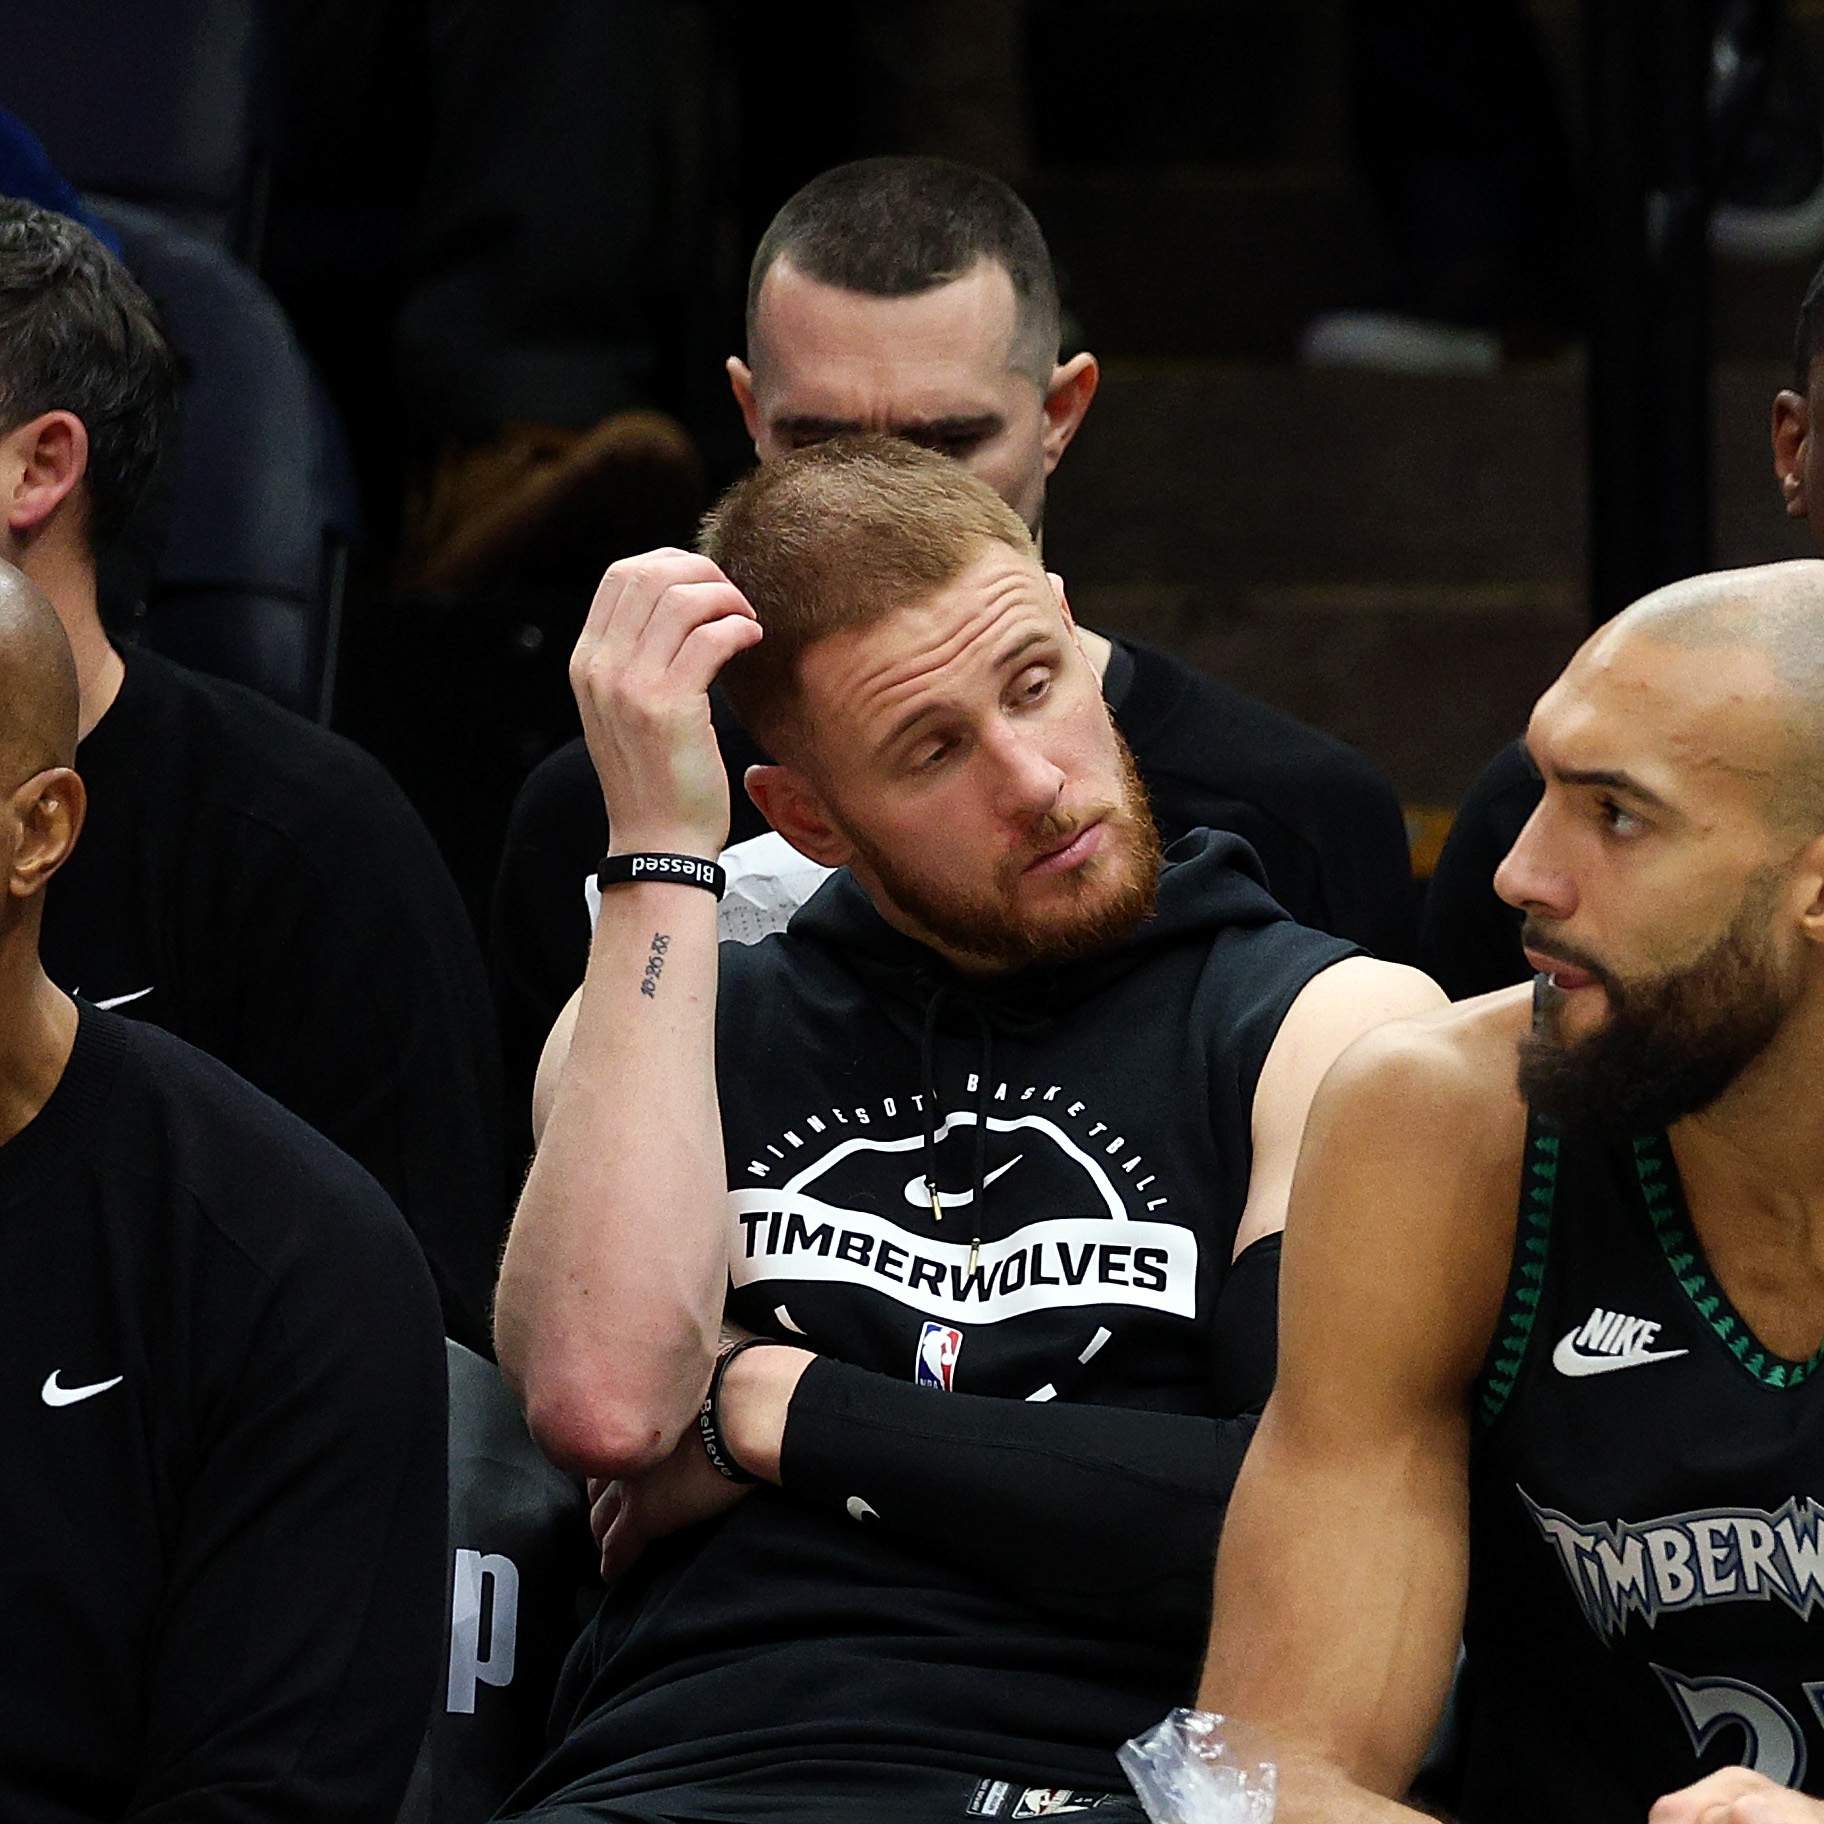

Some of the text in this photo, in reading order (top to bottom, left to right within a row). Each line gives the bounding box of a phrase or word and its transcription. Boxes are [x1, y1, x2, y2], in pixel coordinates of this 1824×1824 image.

[632, 857, 714, 884] Blessed
[747, 1073, 1168, 1212] MINNESOT BASKETBALL
[738, 1211, 1169, 1303] TIMBERWOLVES
[1576, 1307, 1663, 1357] NIKE
